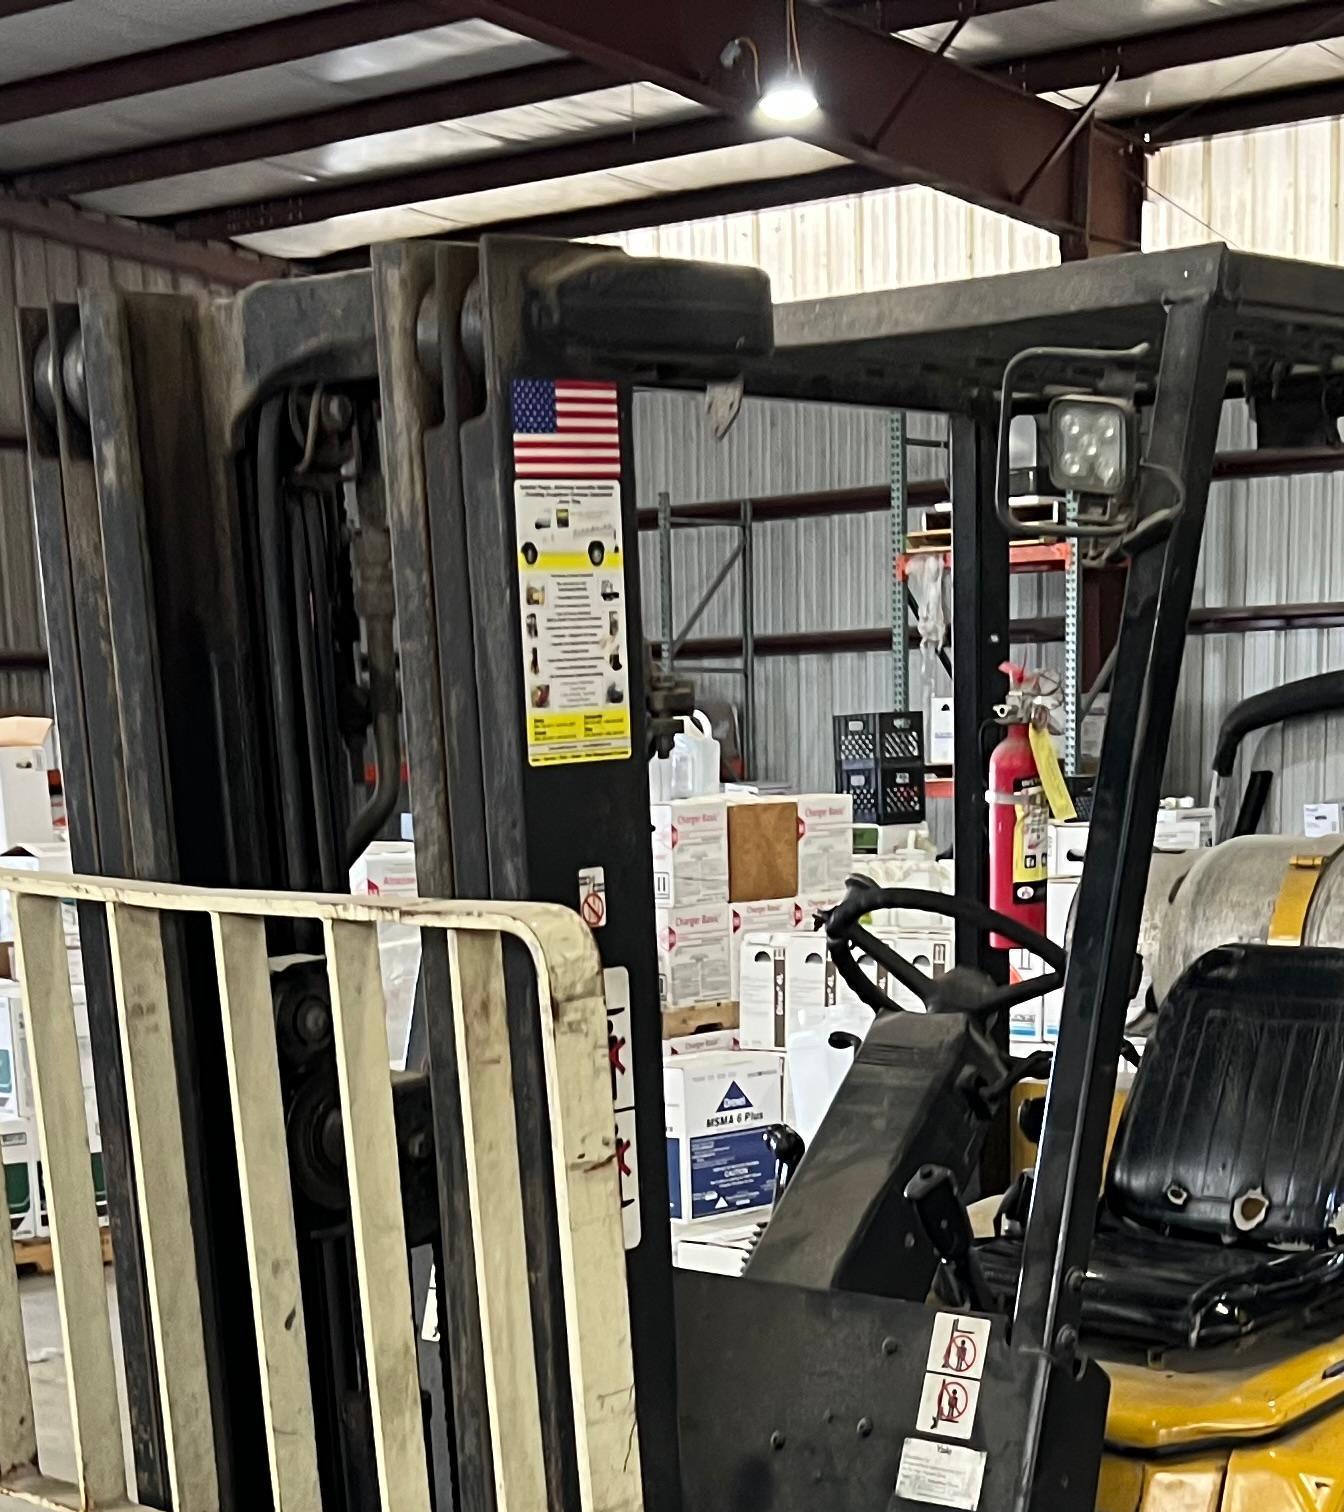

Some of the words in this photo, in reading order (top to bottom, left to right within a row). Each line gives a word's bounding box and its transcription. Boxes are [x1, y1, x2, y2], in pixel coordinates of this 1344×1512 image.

[706, 1115, 734, 1128] MSMA
[737, 1113, 742, 1123] 6
[744, 1112, 764, 1122] Plus
